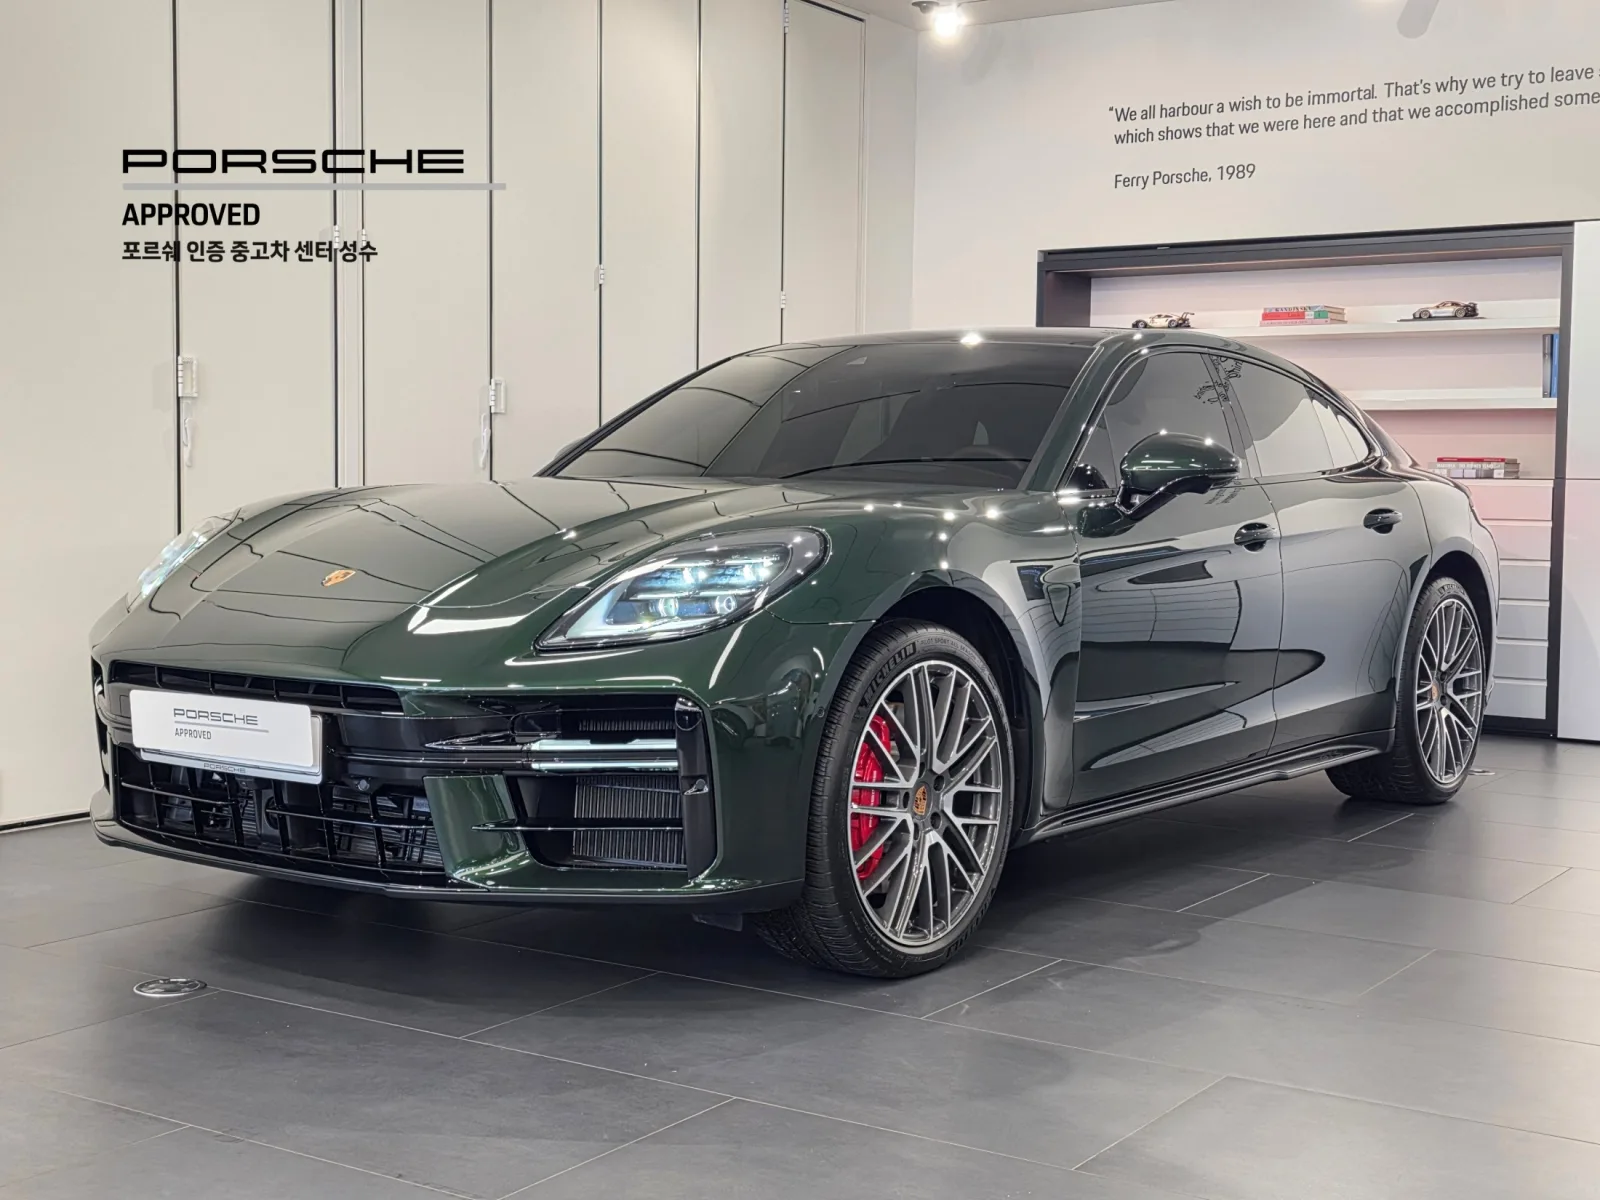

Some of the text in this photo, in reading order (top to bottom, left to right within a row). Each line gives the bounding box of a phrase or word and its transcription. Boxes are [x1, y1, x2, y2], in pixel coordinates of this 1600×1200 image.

[1140, 105, 1156, 120] all
[1159, 101, 1214, 119] harbour
[1216, 101, 1225, 113] a
[1228, 95, 1262, 112] wish
[1266, 94, 1281, 109] to
[1285, 92, 1304, 108] be
[1307, 83, 1378, 106] immortal.
[1384, 79, 1431, 98] That's
[1435, 76, 1468, 95] why
[1472, 75, 1496, 89] we
[1501, 72, 1524, 90] try
[1528, 70, 1546, 85] to
[1550, 66, 1594, 82] leave
[1114, 91, 1600, 144] which shows that we were here and that we accomplished some
[1114, 163, 1256, 190] Ferry Porsche, 1989
[861, 641, 917, 706] MICHELIN
[173, 708, 258, 726] PORSCHE
[174, 727, 212, 740] APPROVED
[203, 763, 246, 773] PORSCHE
